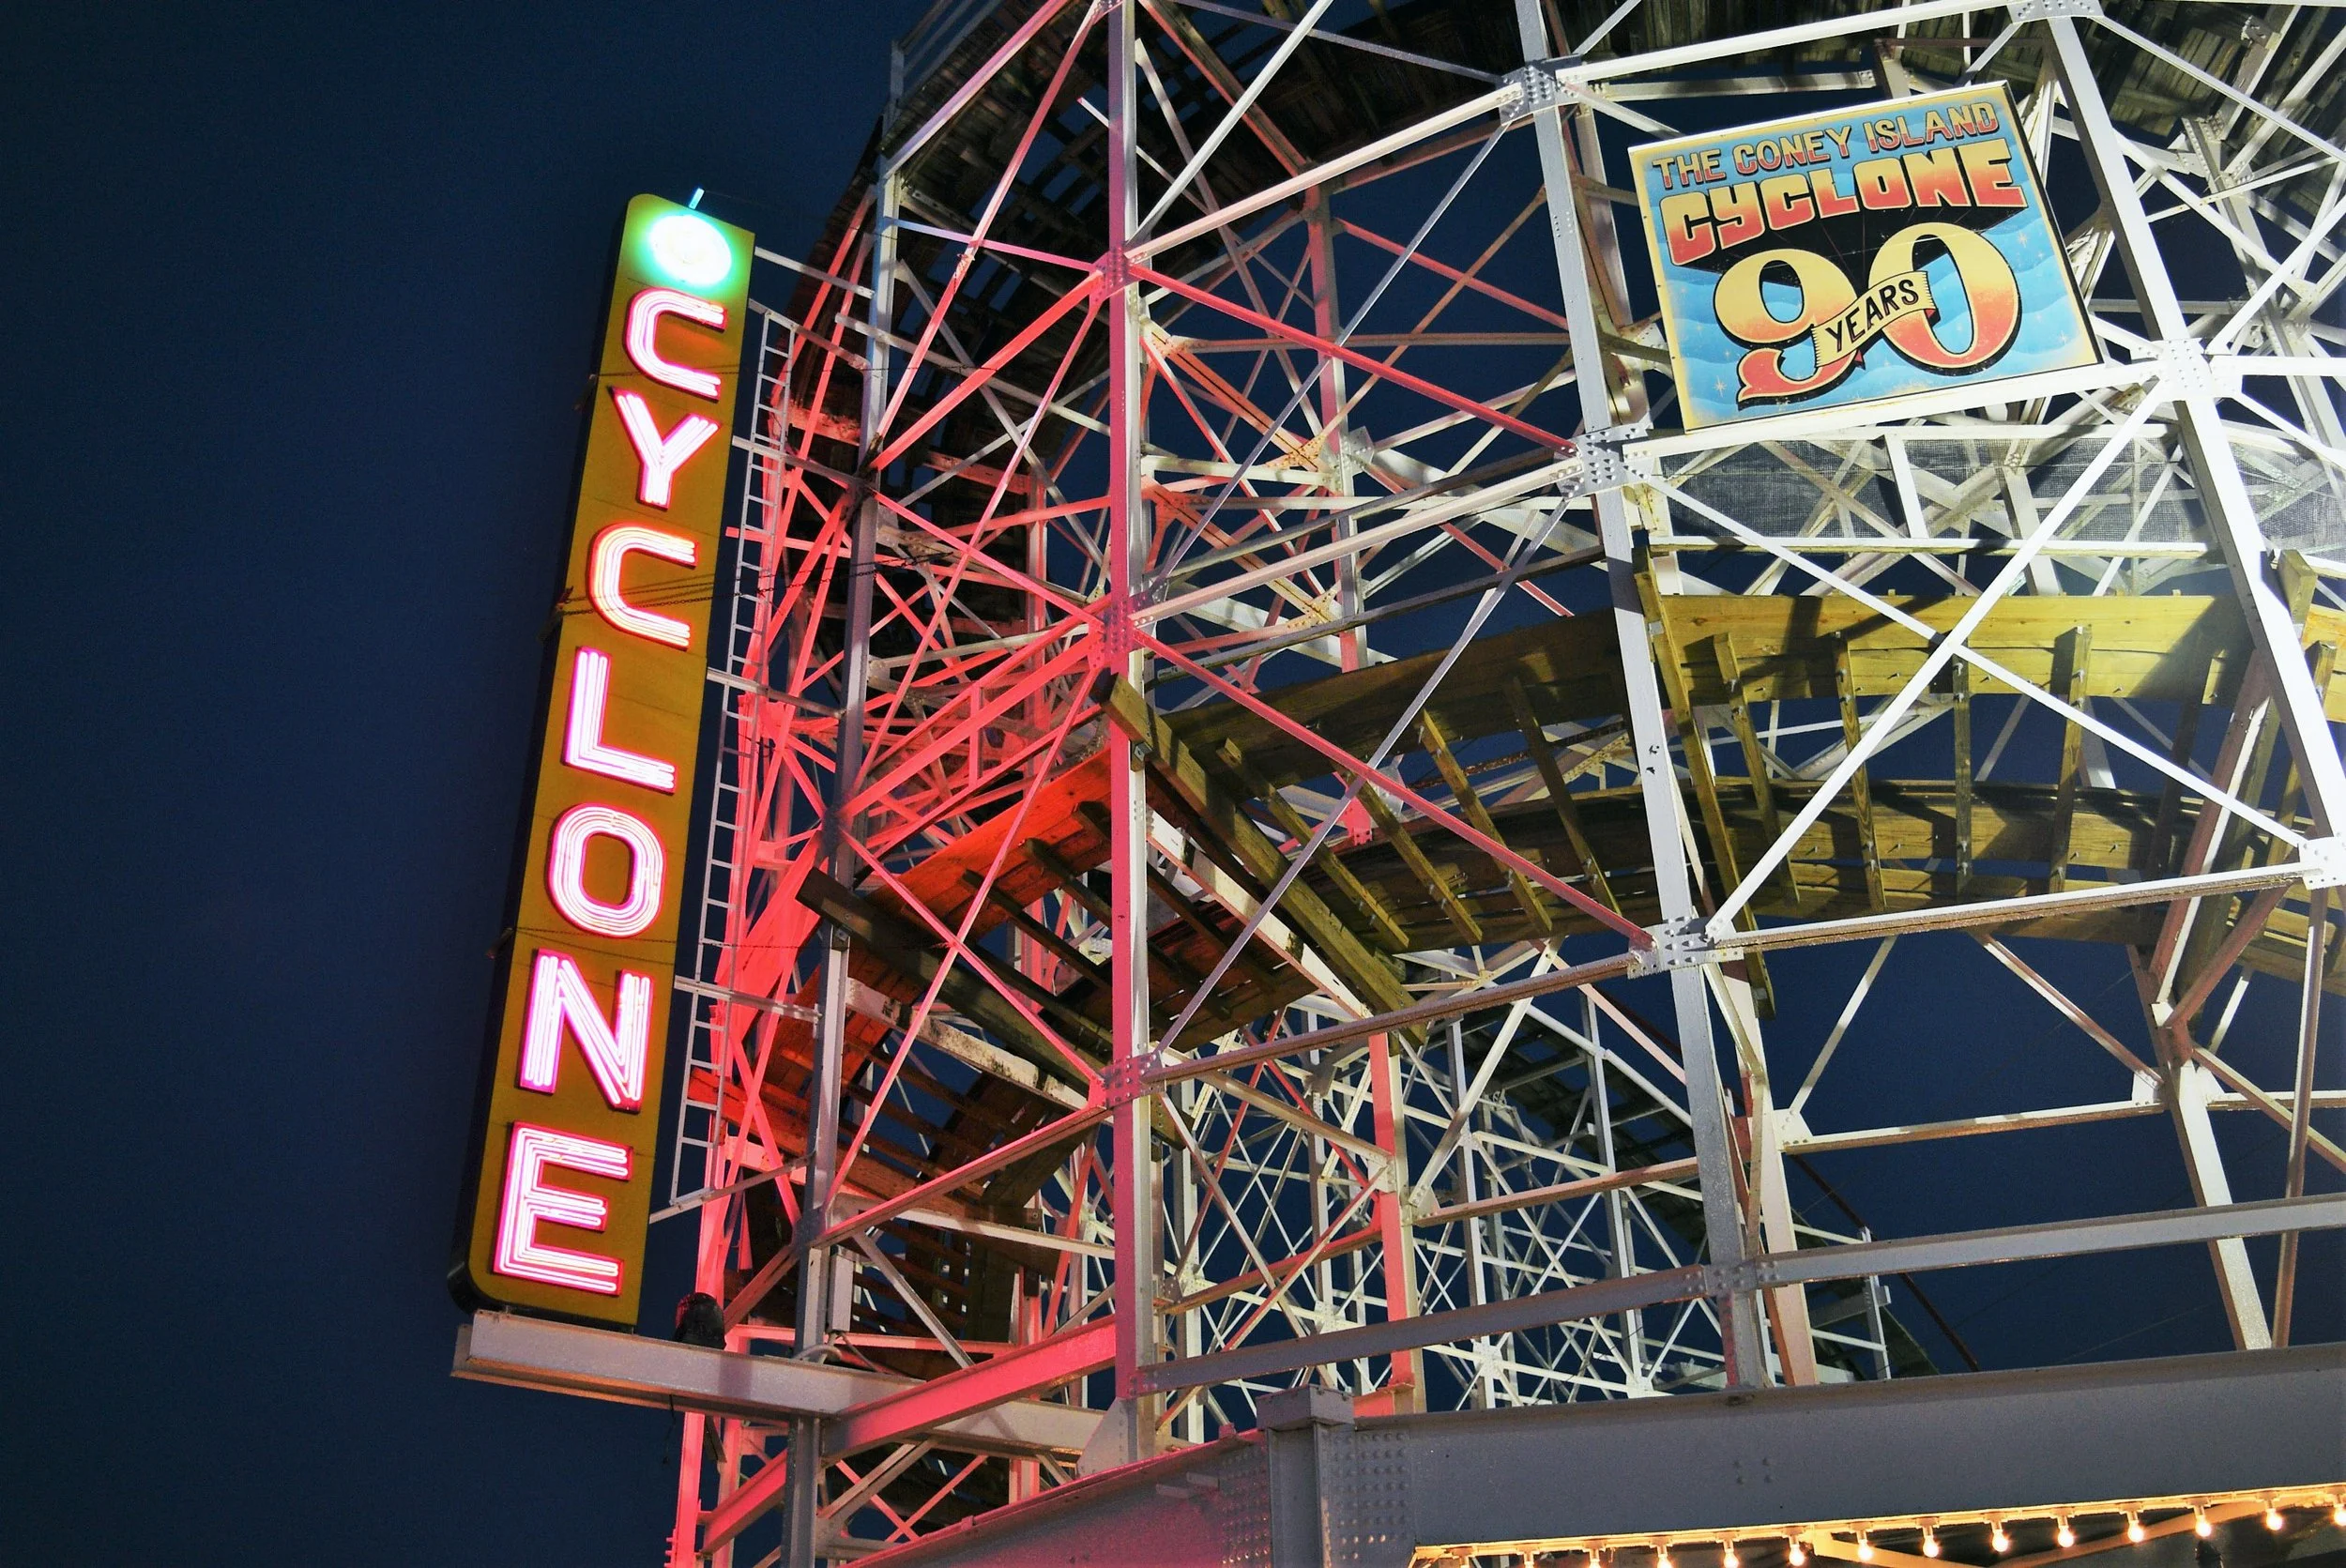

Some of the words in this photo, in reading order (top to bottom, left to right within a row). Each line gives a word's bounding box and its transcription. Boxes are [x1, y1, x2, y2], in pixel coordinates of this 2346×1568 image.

[1652, 148, 1726, 190] THE
[1733, 125, 1852, 176] CONEY
[1863, 101, 2000, 154] ISLAND
[1660, 138, 2028, 266] CYCLONE
[1714, 221, 2022, 410] 90
[1825, 279, 1920, 354] YEARS
[493, 286, 729, 1297] CYCLONE
